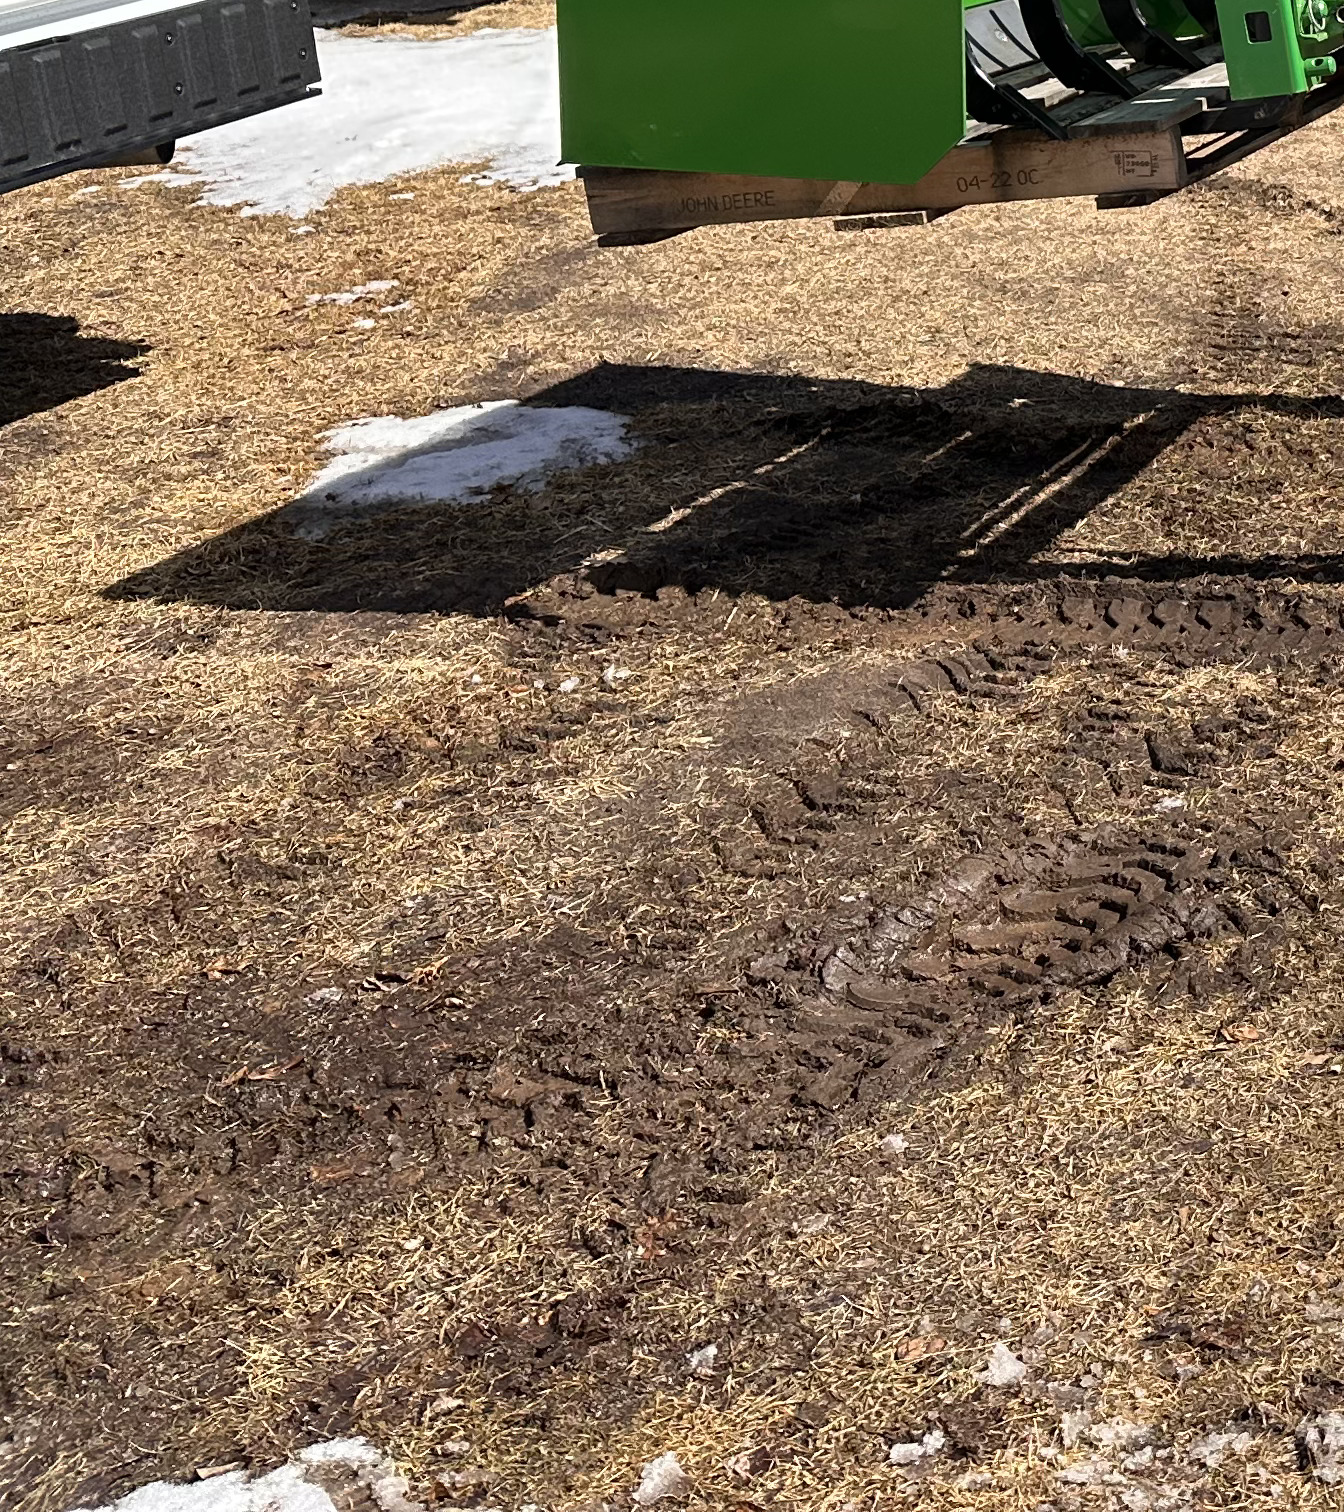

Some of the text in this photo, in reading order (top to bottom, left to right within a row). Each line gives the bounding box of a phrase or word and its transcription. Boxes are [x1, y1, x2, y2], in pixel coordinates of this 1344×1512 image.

[956, 170, 1012, 193] 04-22
[677, 190, 777, 213] JOHN DEERE
